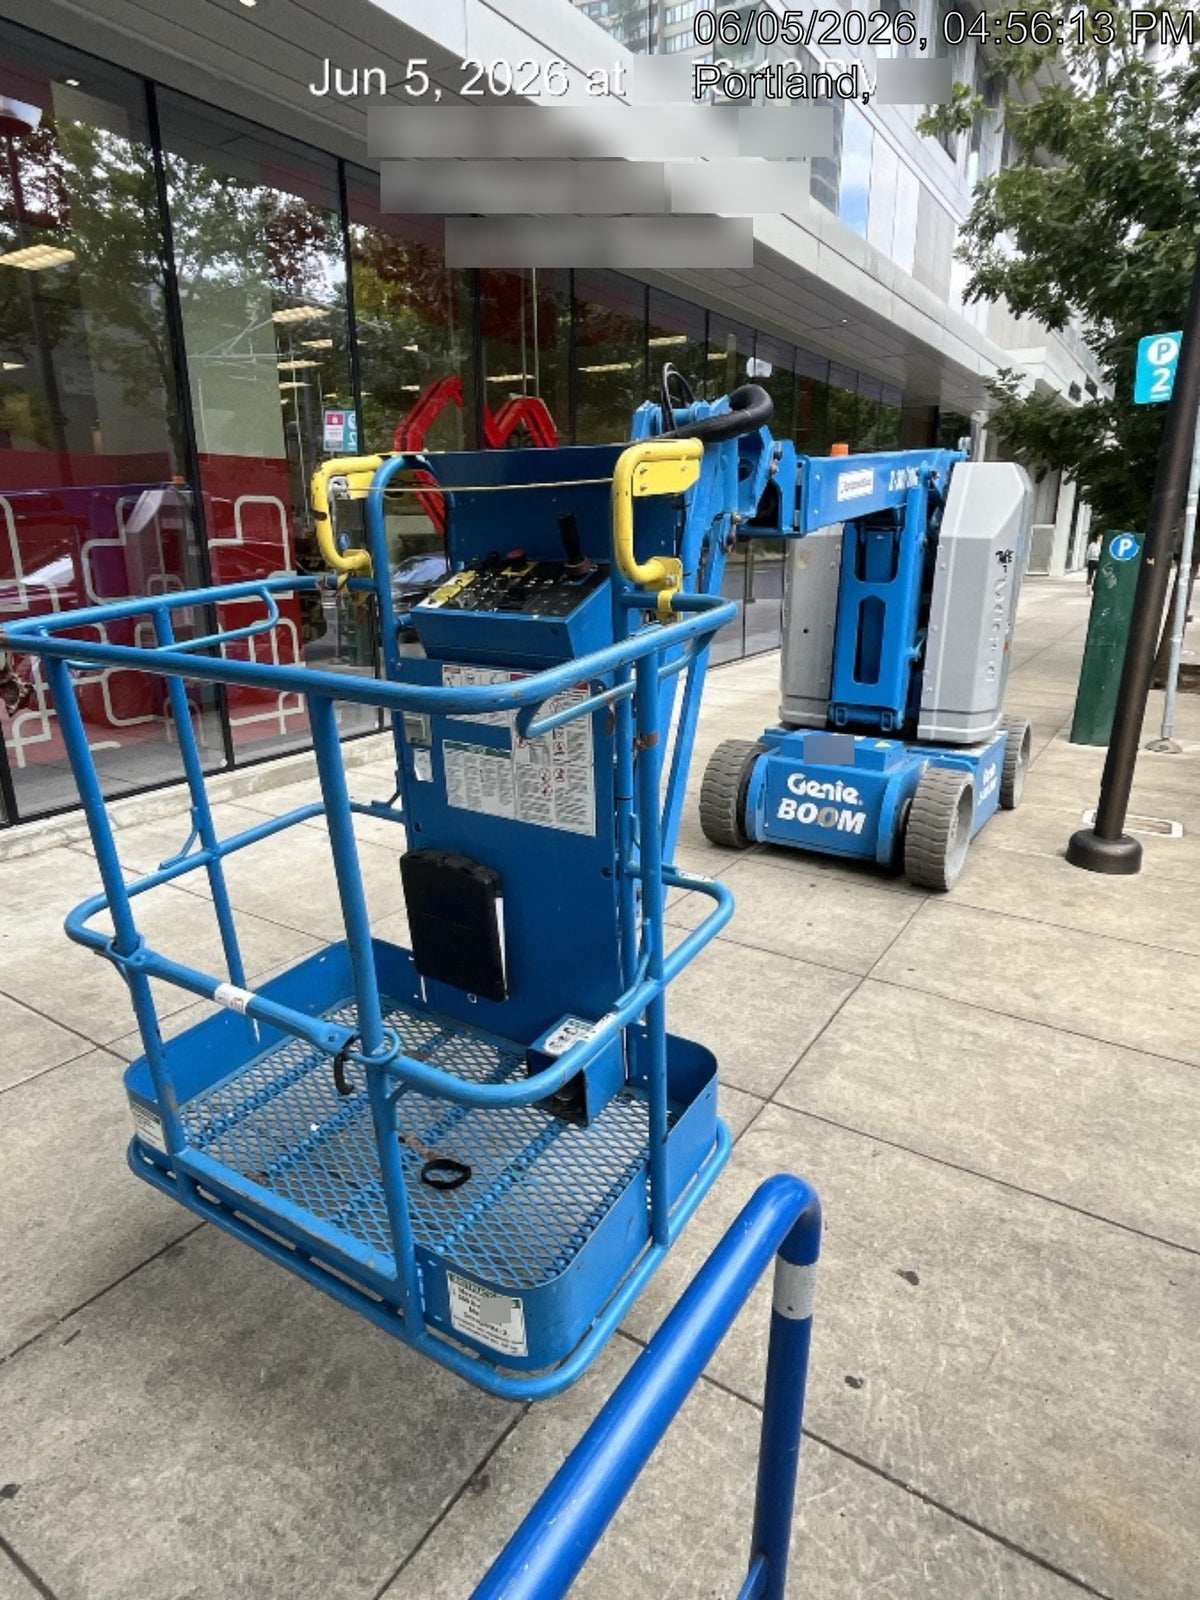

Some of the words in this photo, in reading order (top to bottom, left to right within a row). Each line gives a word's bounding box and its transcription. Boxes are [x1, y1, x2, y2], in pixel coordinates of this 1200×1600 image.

[1156, 342, 1172, 361] P
[1150, 367, 1172, 392] 2
[1117, 538, 1133, 557] P
[787, 772, 861, 805] Genie
[777, 797, 867, 834] BOOM
